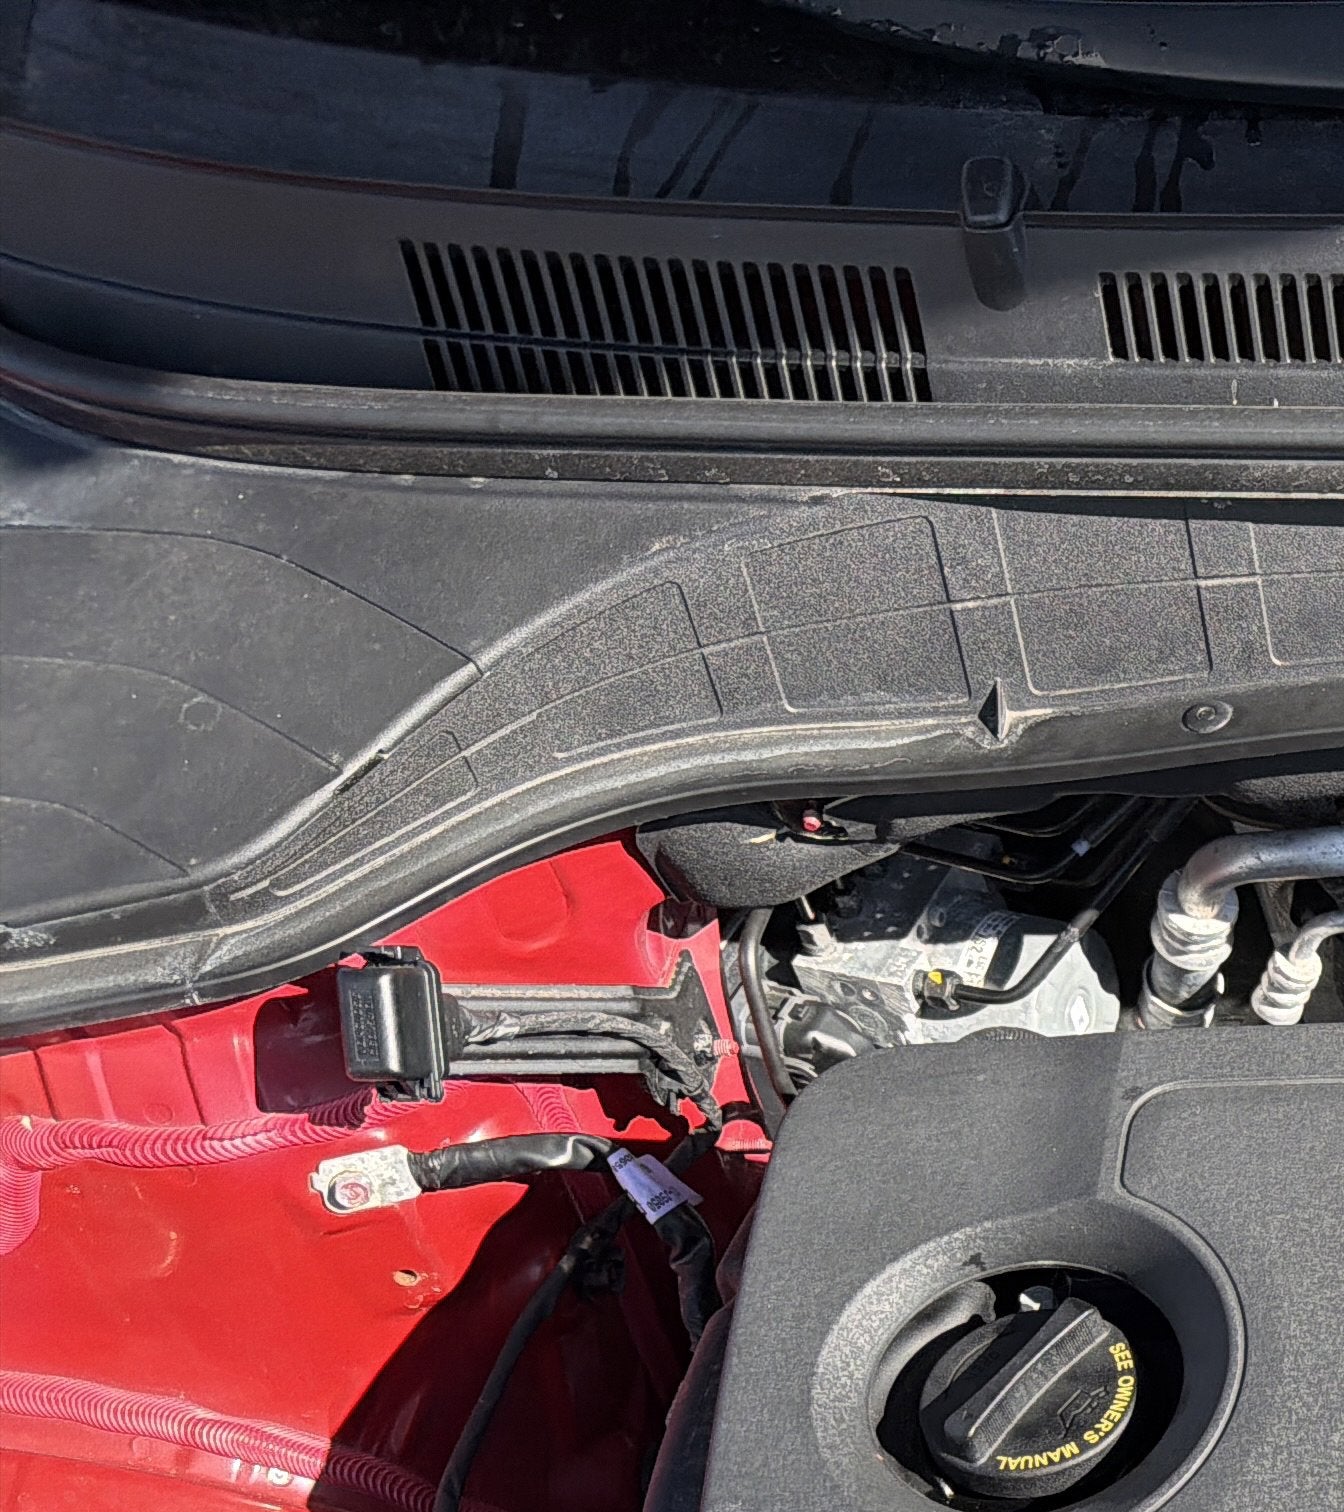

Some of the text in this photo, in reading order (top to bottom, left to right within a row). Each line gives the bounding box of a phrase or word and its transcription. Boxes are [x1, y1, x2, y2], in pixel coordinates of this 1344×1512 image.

[1108, 1342, 1134, 1371] SEE
[1083, 1375, 1135, 1444] OWNER'S
[996, 1441, 1080, 1470] MANUAL
